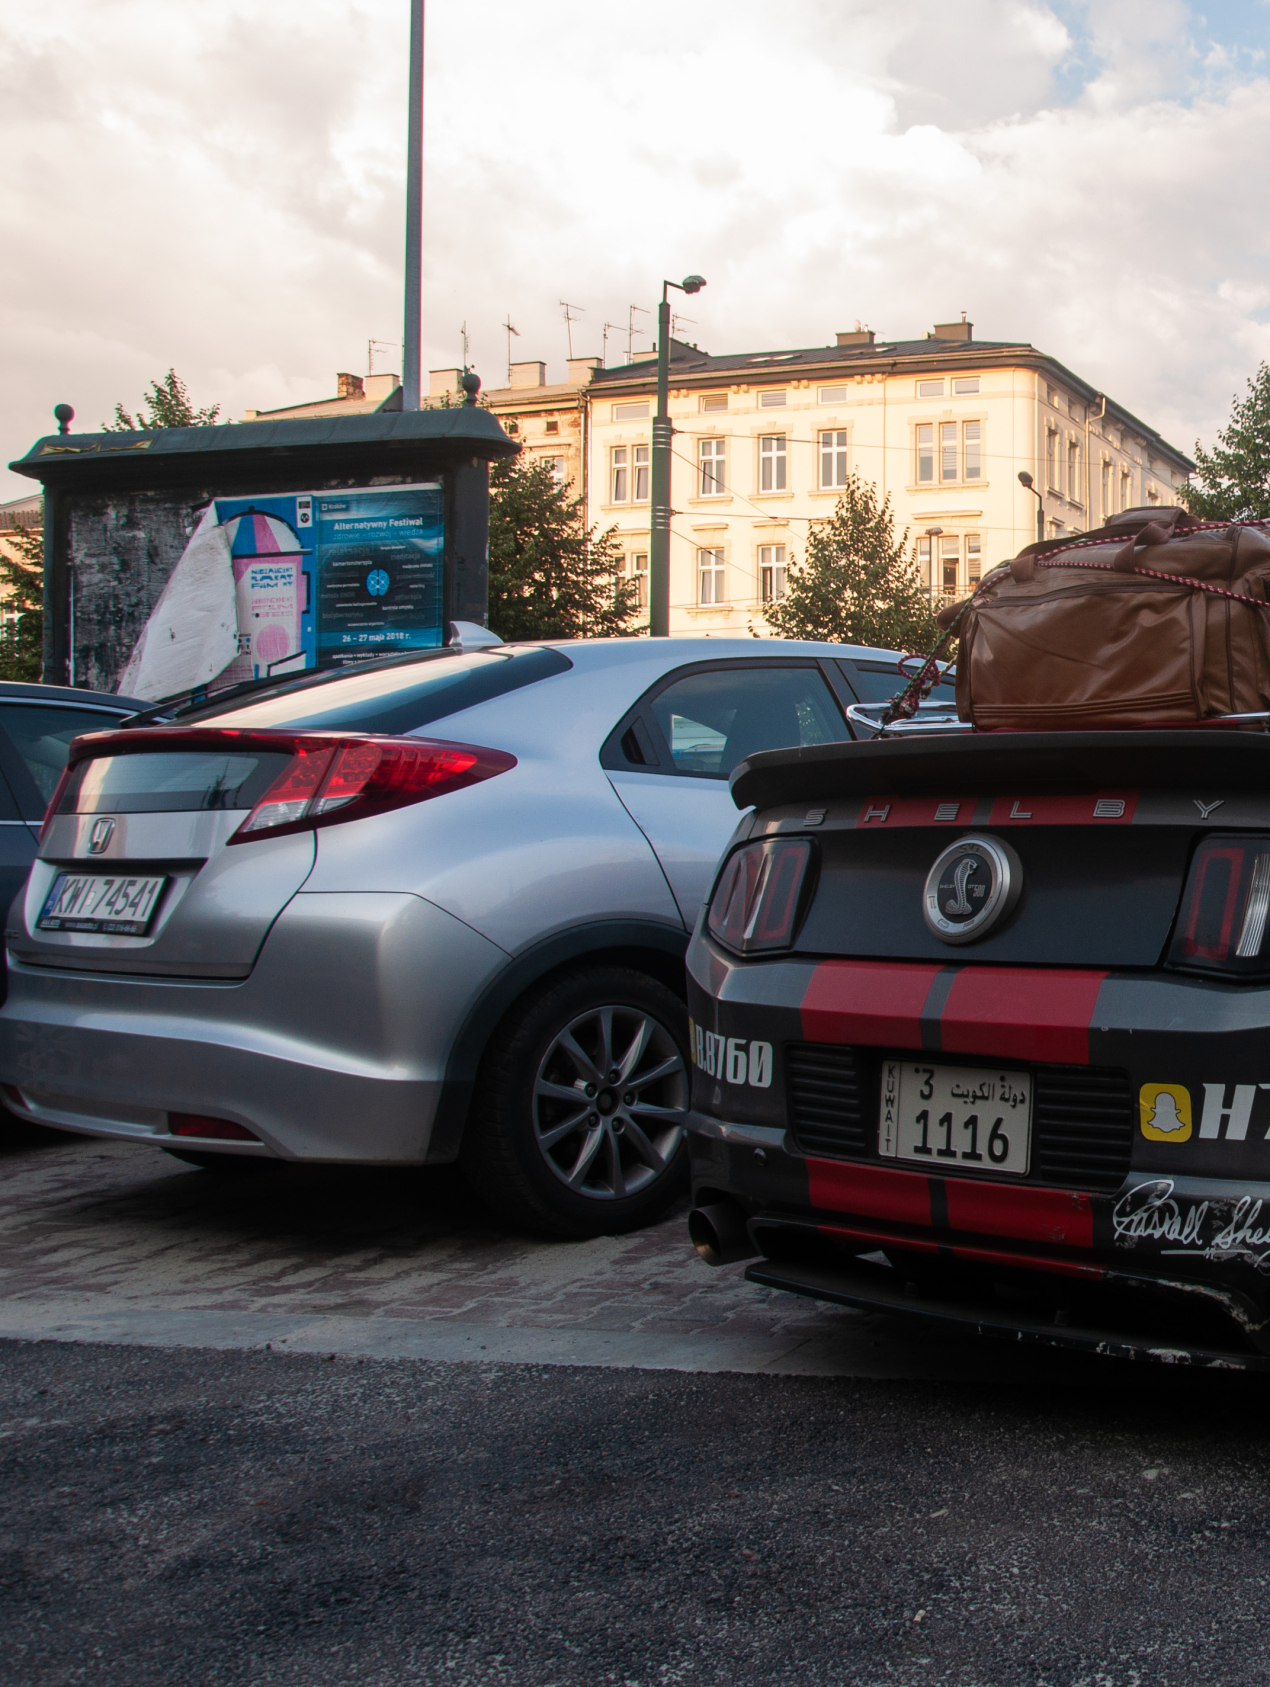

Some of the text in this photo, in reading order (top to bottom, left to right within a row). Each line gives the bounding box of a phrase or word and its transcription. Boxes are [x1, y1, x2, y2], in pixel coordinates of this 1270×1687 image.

[333, 517, 423, 531] Alternatywny Festiwal
[342, 634, 351, 642] 26
[358, 634, 368, 642] 27
[369, 633, 385, 642] maja
[386, 632, 404, 640] 2018
[802, 799, 1225, 827] SHELBY
[53, 878, 160, 918] KWI 74541
[695, 1023, 773, 1088] B.8760
[919, 1067, 935, 1101] 3
[950, 1075, 1026, 1109] دولة الكويت
[884, 1064, 896, 1152] KUWAIT
[913, 1108, 1010, 1164] 1116
